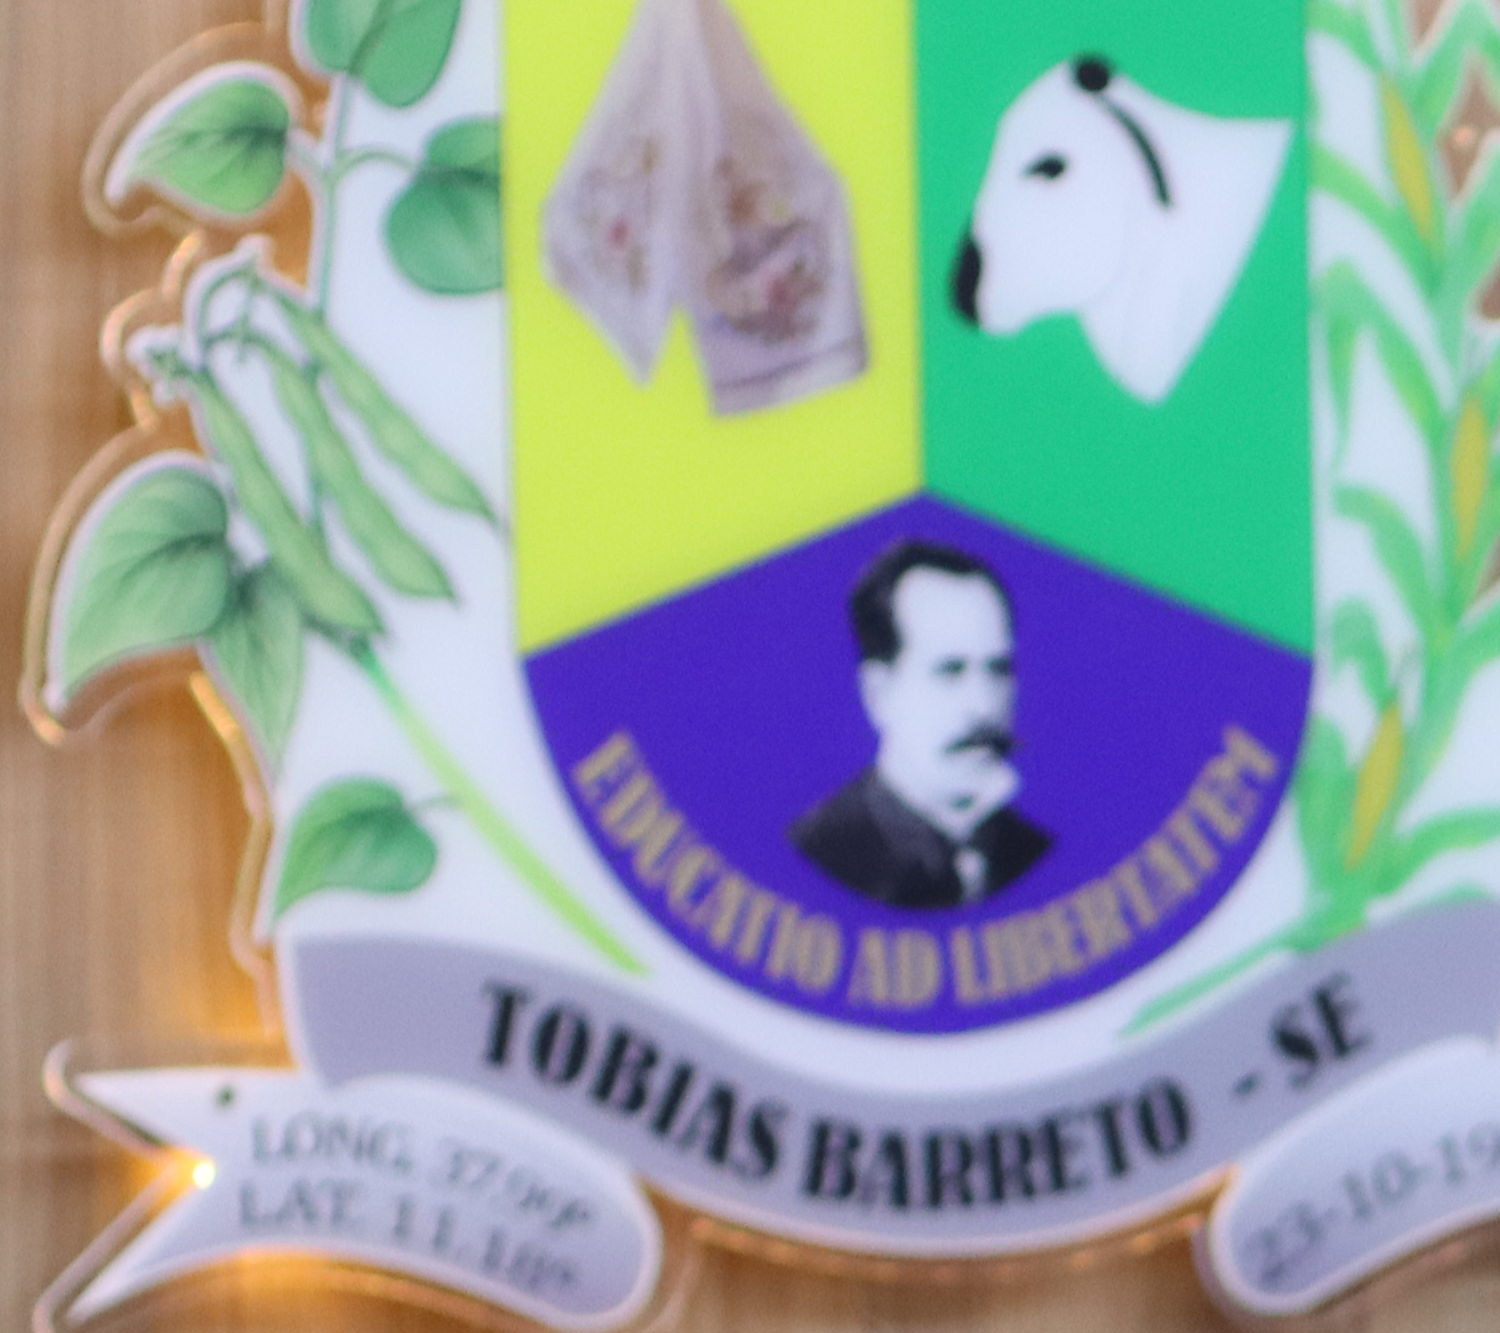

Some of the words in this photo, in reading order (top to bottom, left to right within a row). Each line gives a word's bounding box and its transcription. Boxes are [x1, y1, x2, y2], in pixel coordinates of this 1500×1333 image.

[571, 730, 843, 993] EDUCATIO
[846, 924, 942, 1006] AD
[952, 724, 1279, 1006] LIBERTATEM
[481, 985, 790, 1184] TOBIAS
[804, 1075, 1194, 1212] BARRETO
[1271, 974, 1375, 1090] SE
